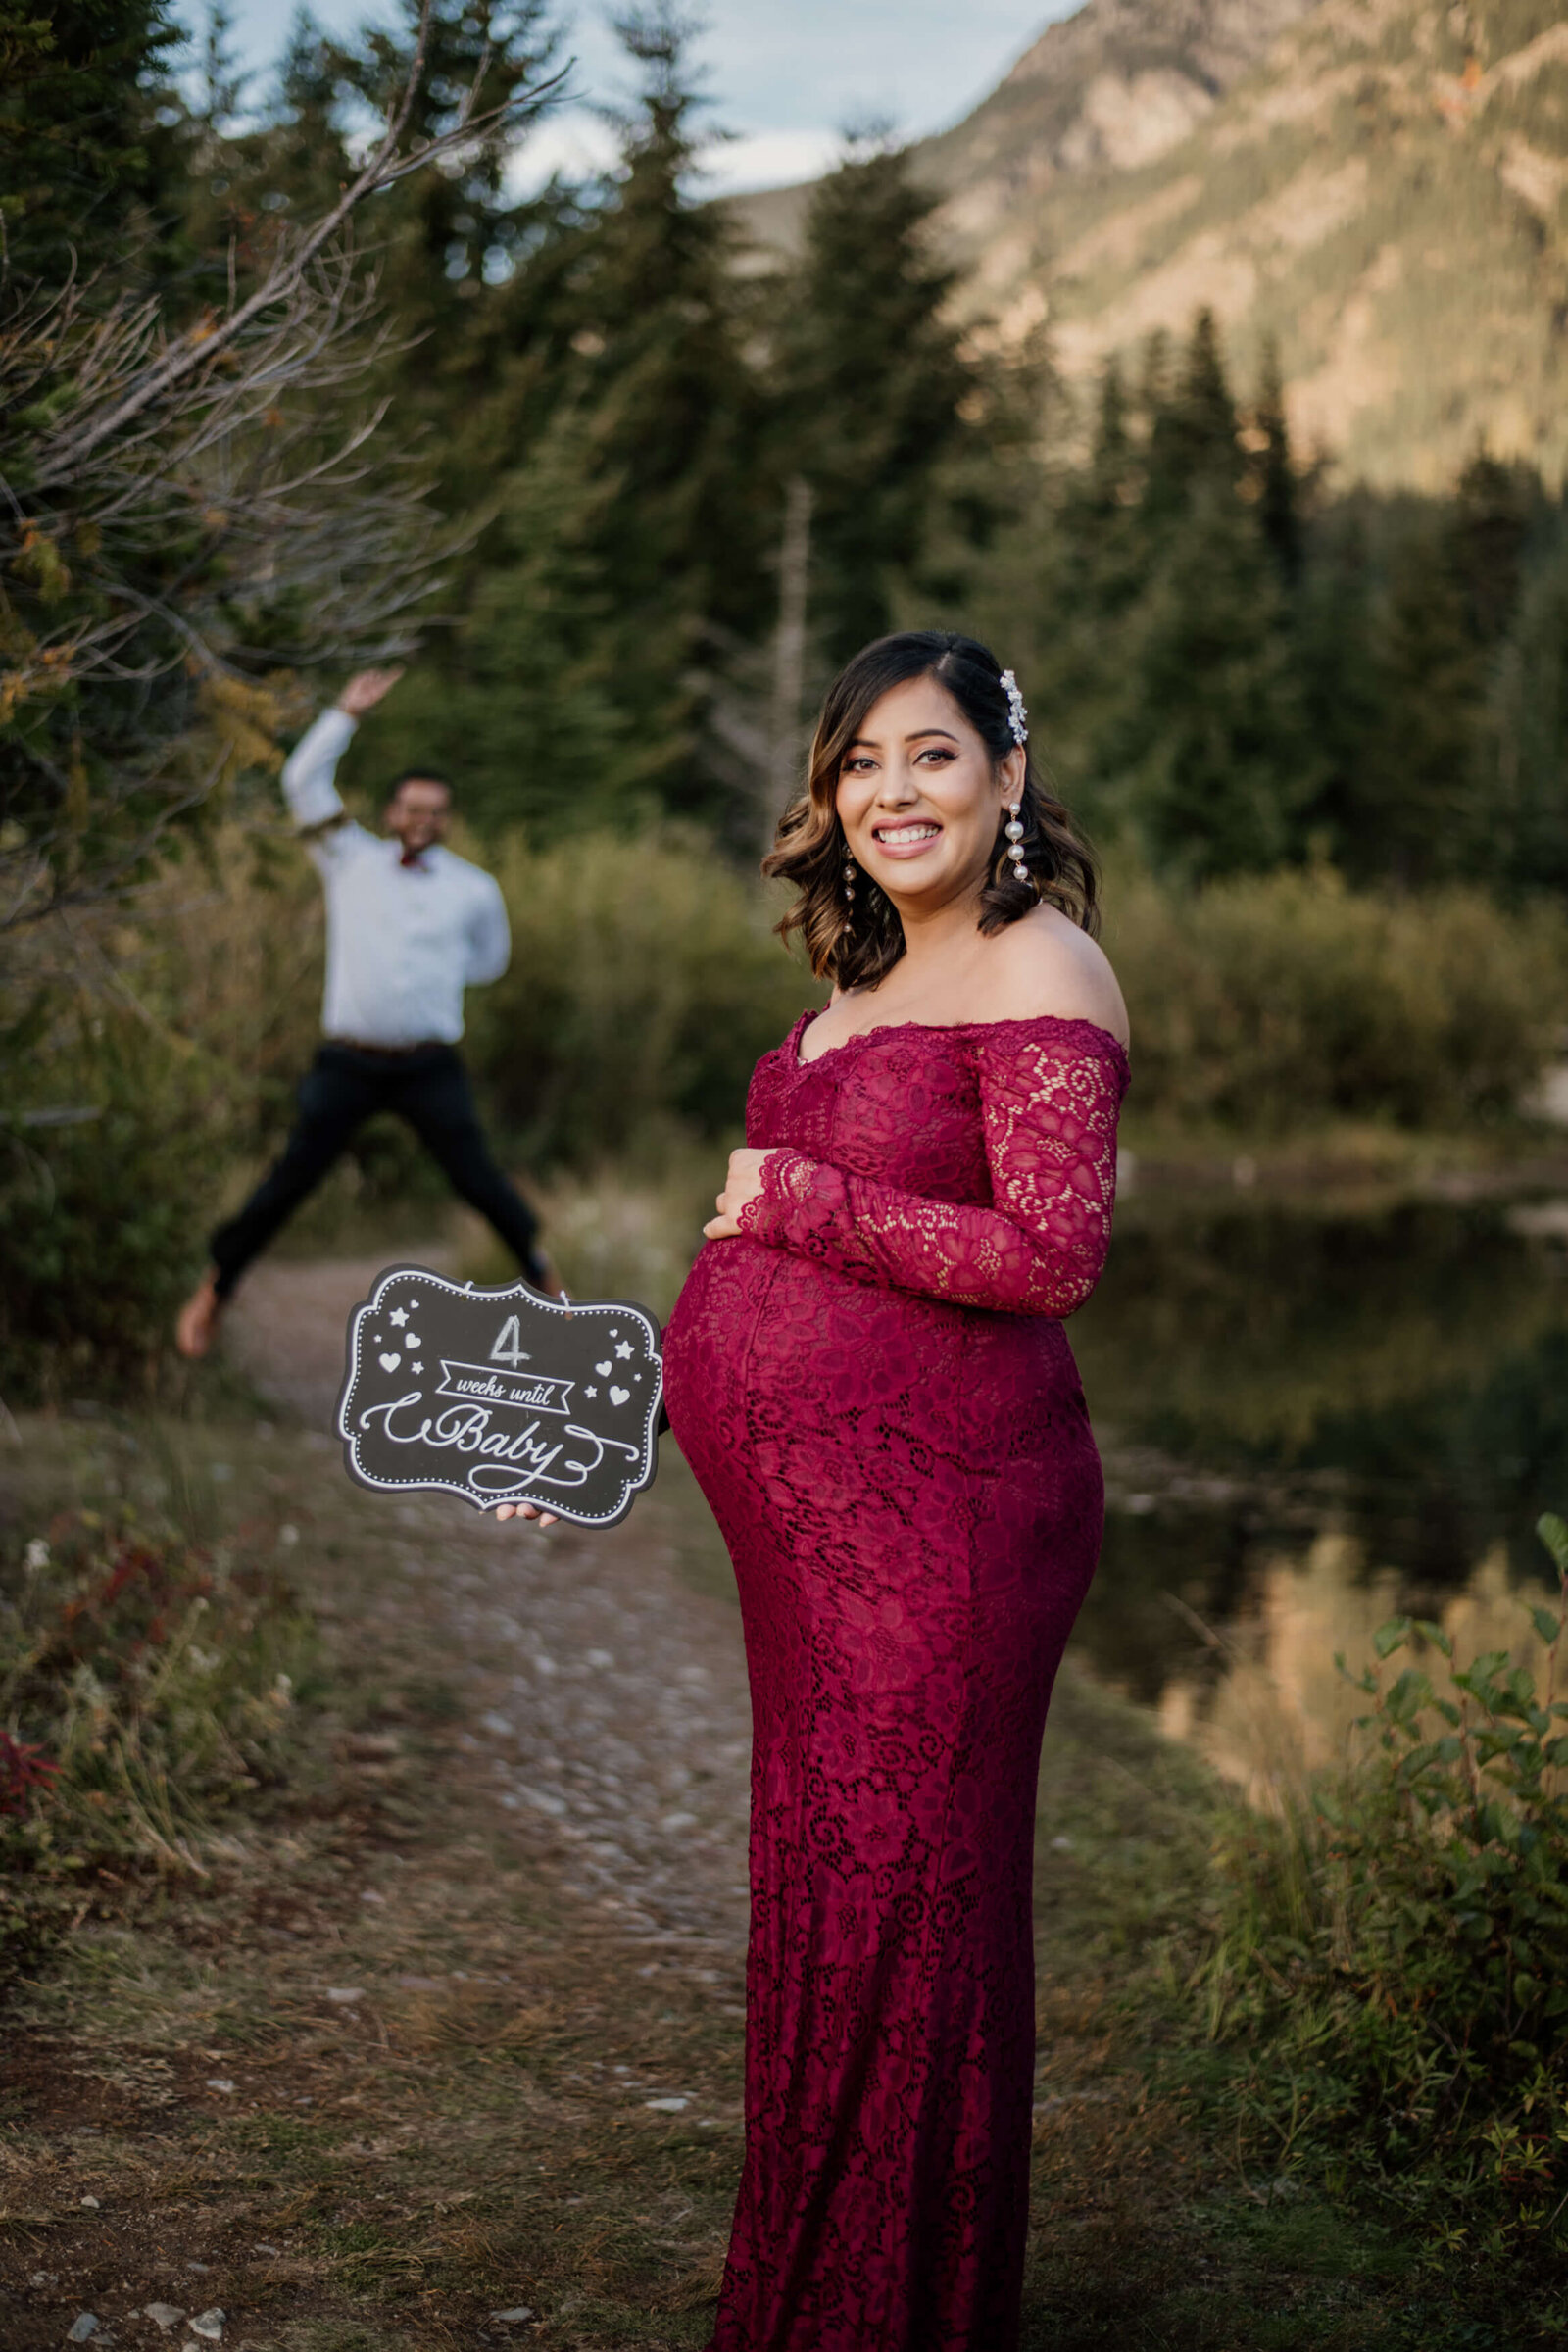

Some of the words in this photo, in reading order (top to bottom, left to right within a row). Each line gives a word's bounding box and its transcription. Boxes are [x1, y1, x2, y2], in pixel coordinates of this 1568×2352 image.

[488, 1314, 532, 1369] 4
[456, 1374, 506, 1397] weeks
[509, 1383, 555, 1406] until
